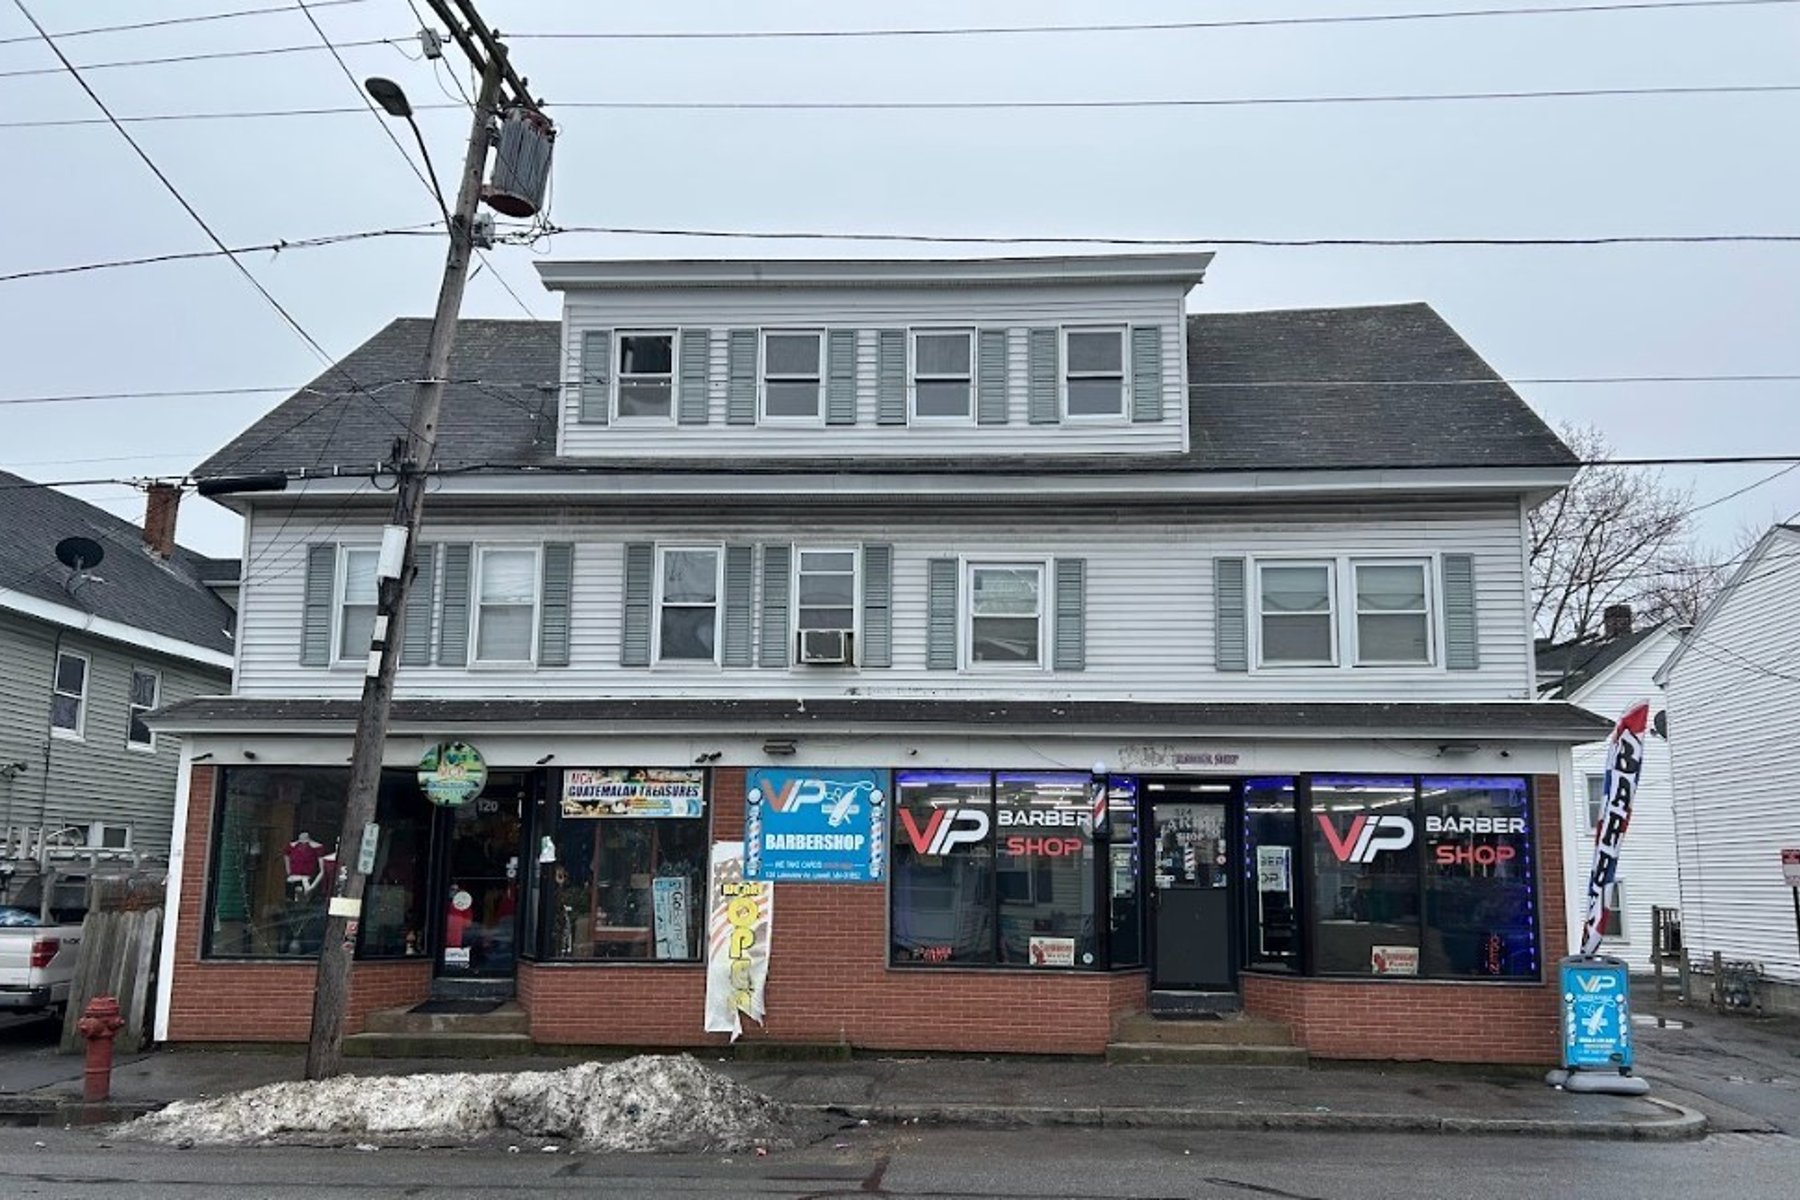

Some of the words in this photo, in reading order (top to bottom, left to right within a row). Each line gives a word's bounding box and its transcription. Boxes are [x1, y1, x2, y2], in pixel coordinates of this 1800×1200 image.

[568, 785, 637, 797] GUATEMALAN
[639, 785, 699, 797] TREASURES
[761, 779, 827, 813] VIP
[479, 800, 498, 812] 120
[998, 810, 1092, 827] BARBER
[1425, 816, 1526, 834] BARBER
[899, 806, 990, 854] VIP
[765, 833, 865, 850] BARBERSHOP
[1007, 837, 1083, 856] SHOP
[1436, 845, 1516, 865] SHOP
[1576, 975, 1616, 993] VIP
